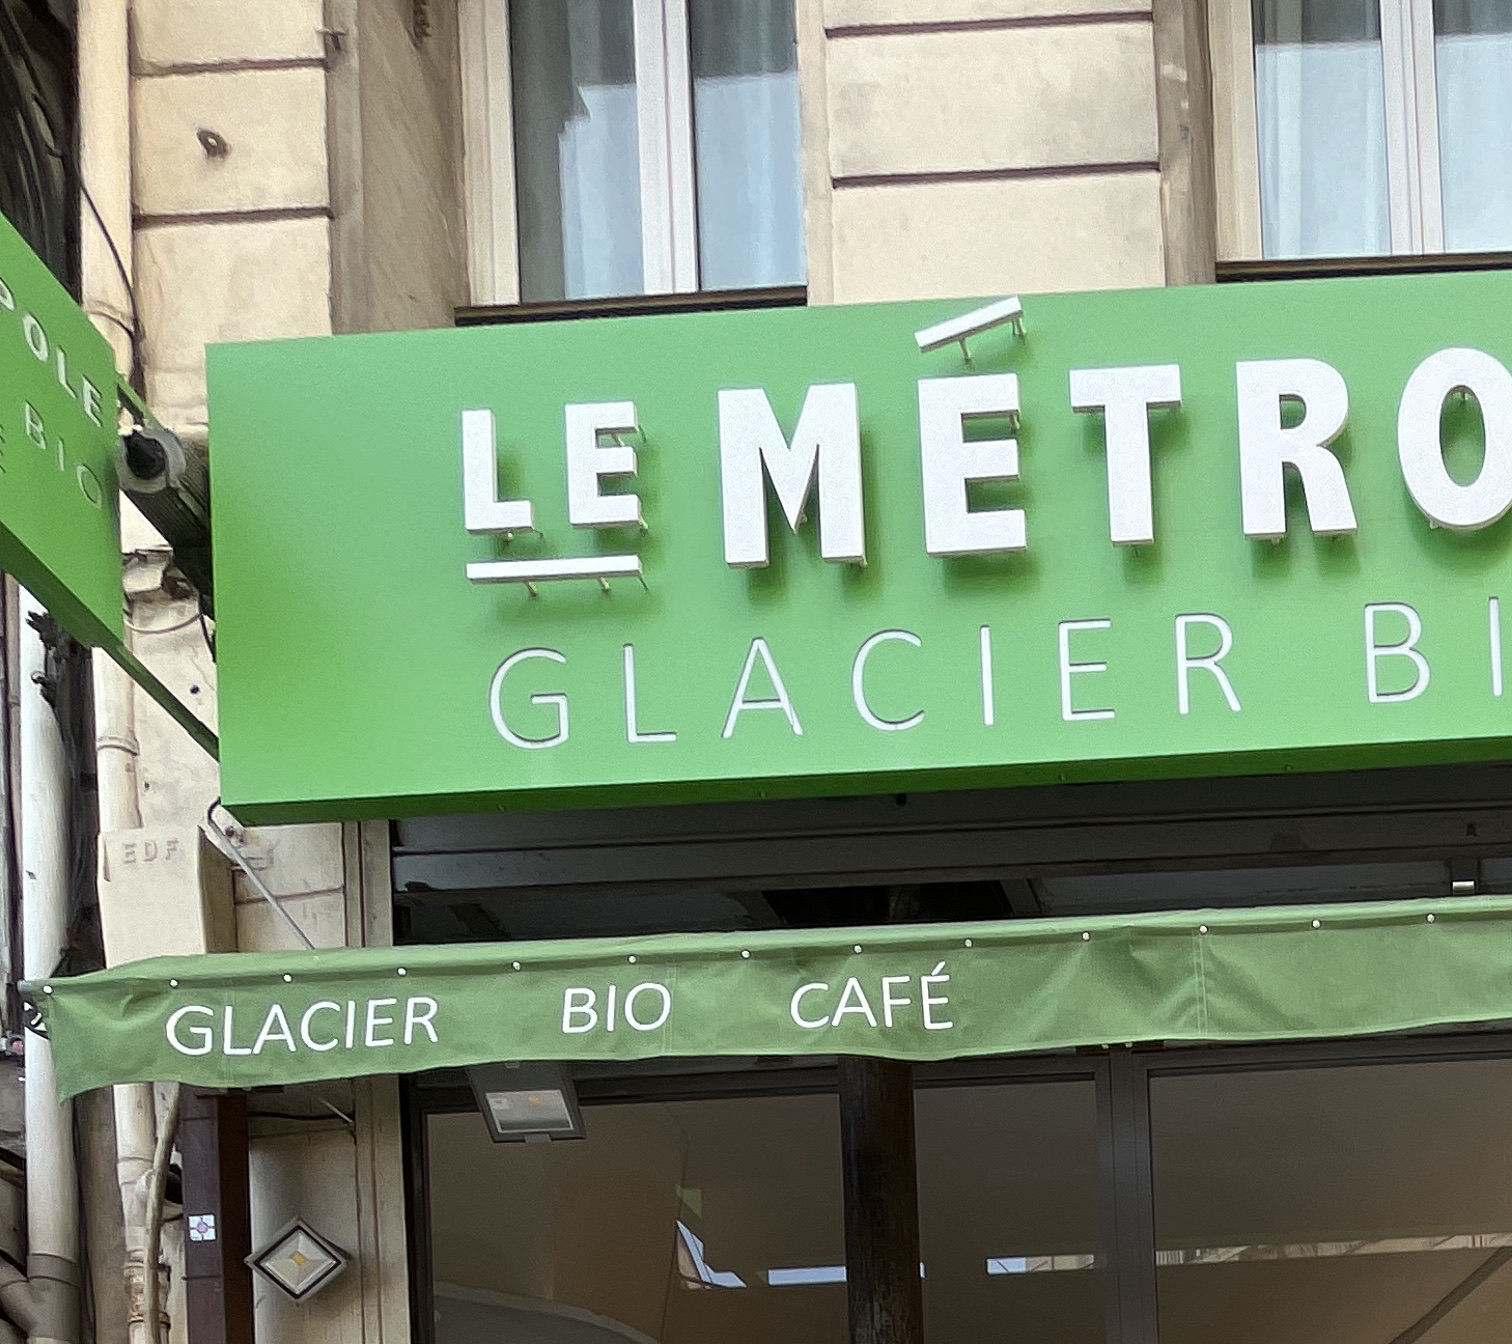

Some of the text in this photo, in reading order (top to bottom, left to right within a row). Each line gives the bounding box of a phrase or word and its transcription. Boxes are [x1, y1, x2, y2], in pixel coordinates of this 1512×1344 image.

[25, 401, 102, 511] BIO
[461, 401, 642, 534] LE
[488, 613, 1242, 750] GLACIER
[164, 961, 955, 1059] GLACIER BIO CAFÉ
